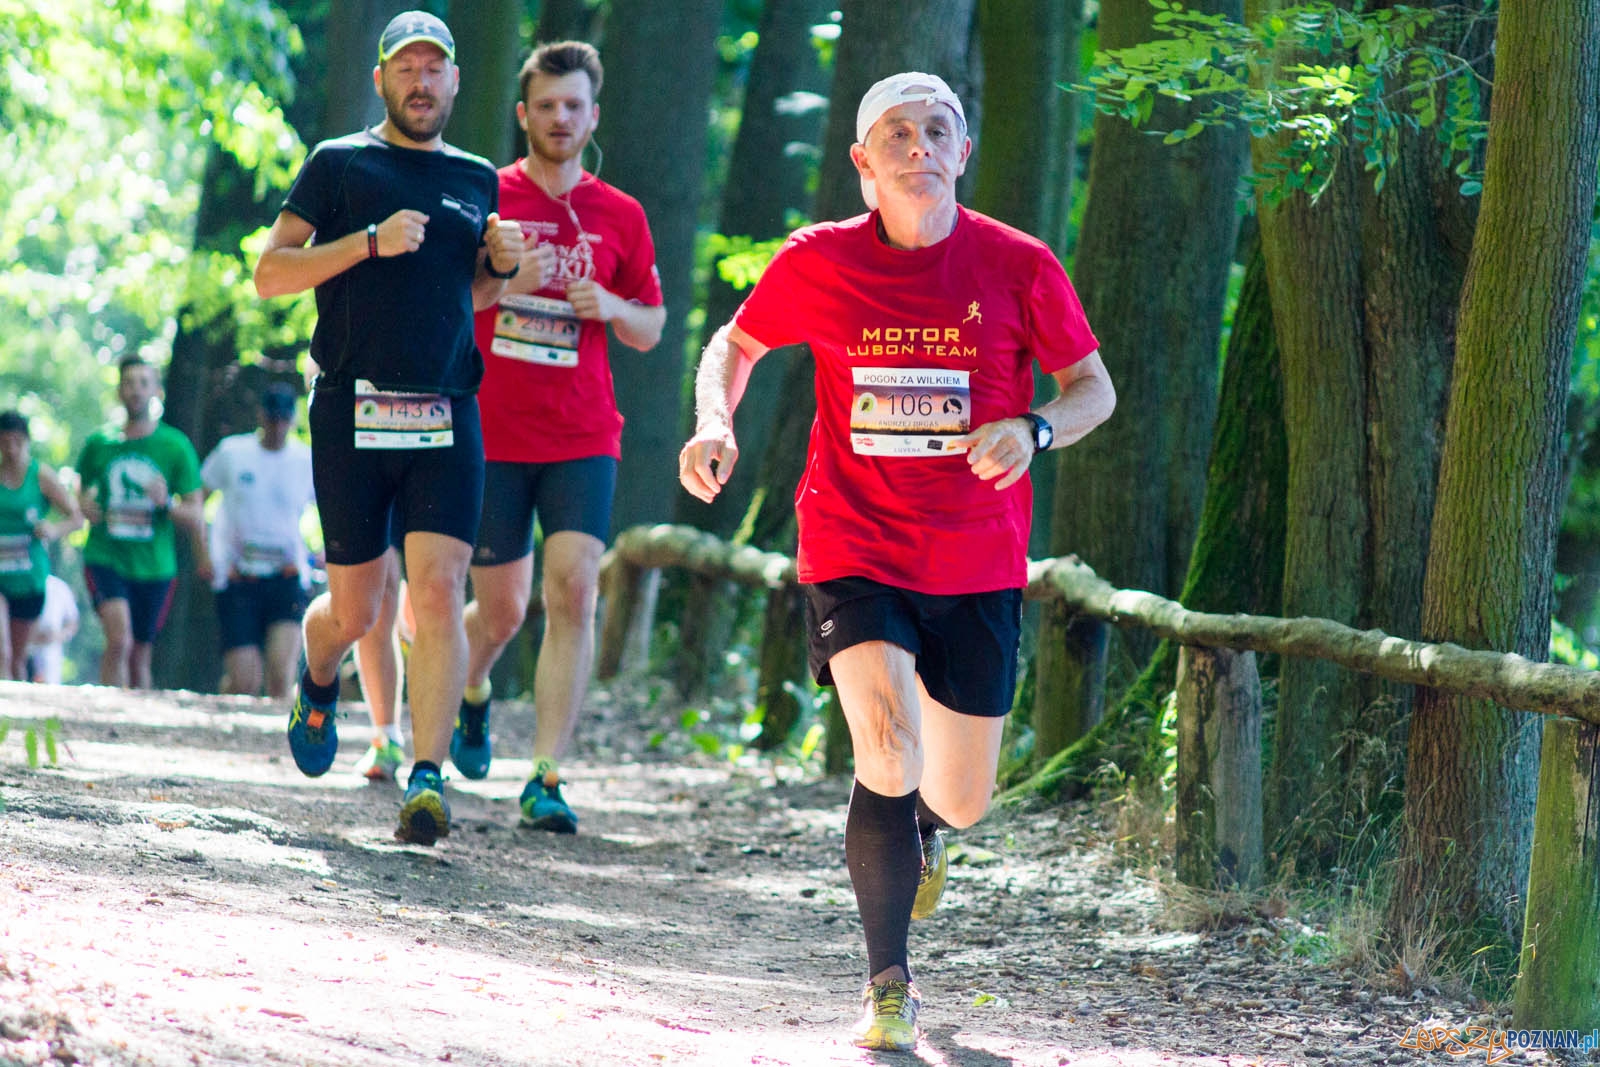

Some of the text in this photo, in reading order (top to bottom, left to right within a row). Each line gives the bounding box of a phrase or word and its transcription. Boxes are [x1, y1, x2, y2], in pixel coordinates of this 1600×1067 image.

[862, 328, 960, 342] MOTOR
[846, 342, 977, 357] LUBOŃ TEAM
[900, 376, 914, 384] ZA
[917, 376, 960, 385] WILKIEM
[390, 401, 423, 418] 143
[888, 392, 932, 416] 106
